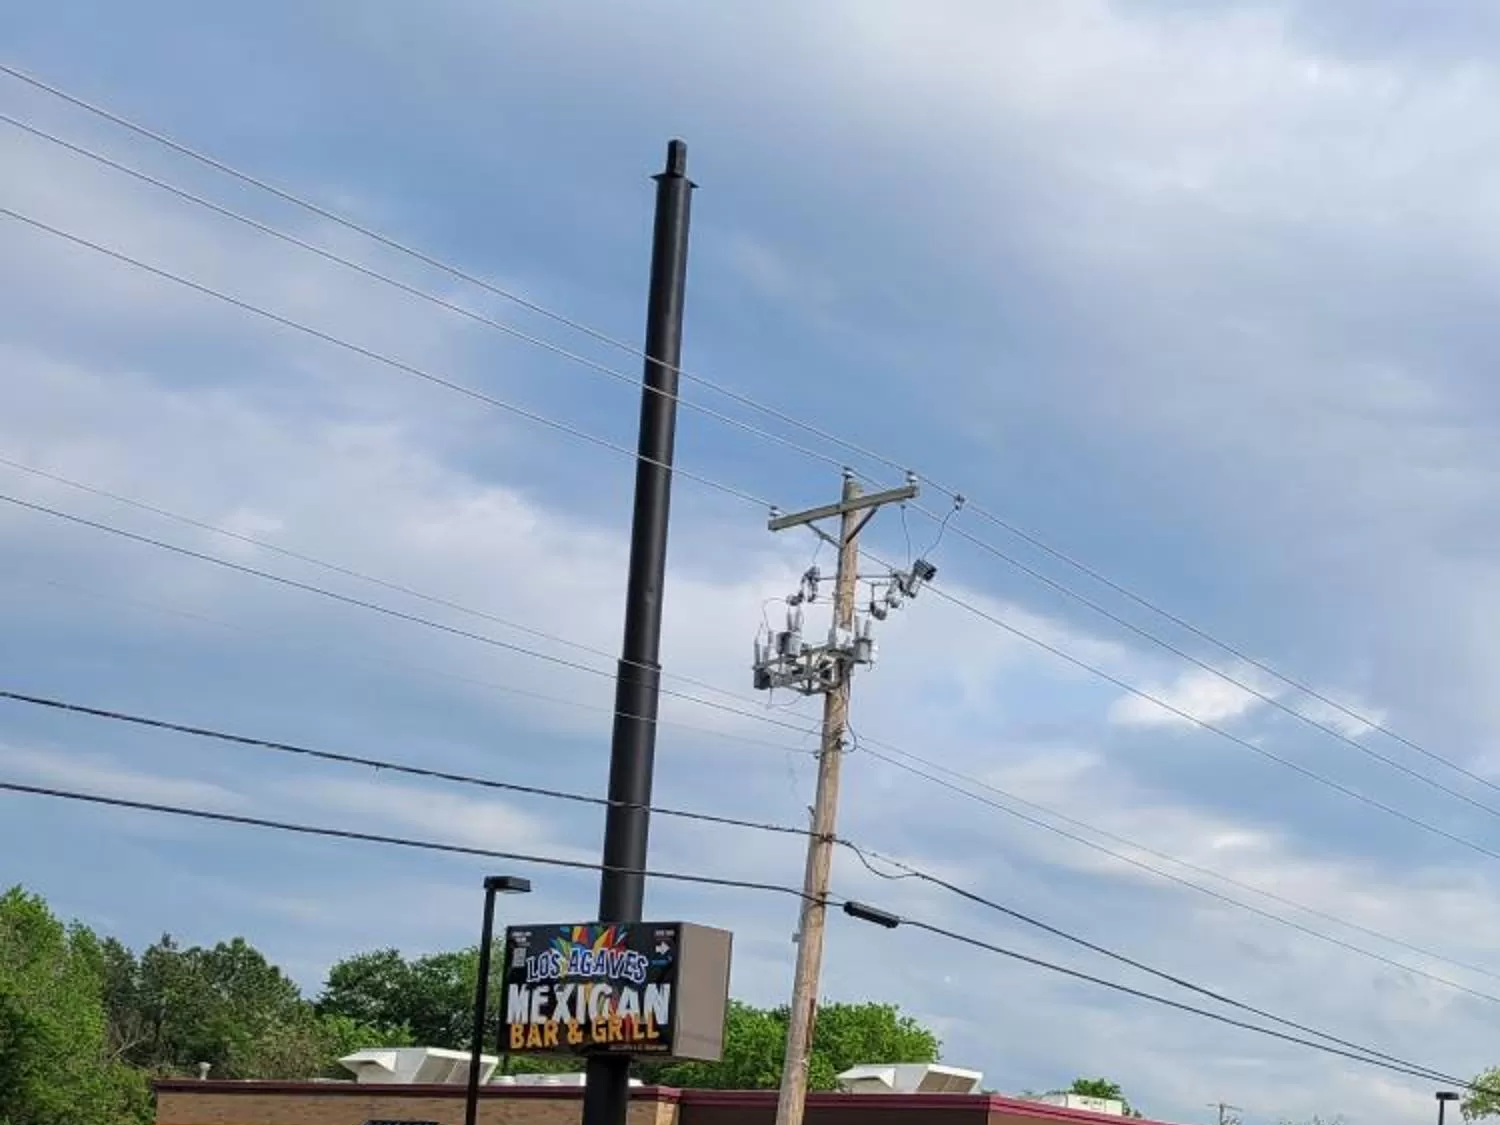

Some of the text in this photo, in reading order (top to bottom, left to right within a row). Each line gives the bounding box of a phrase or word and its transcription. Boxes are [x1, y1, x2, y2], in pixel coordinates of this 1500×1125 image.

[526, 948, 649, 984] LOS AGAVES
[506, 983, 671, 1025] MEXICAN
[510, 1014, 660, 1049] BAR & GRILL
